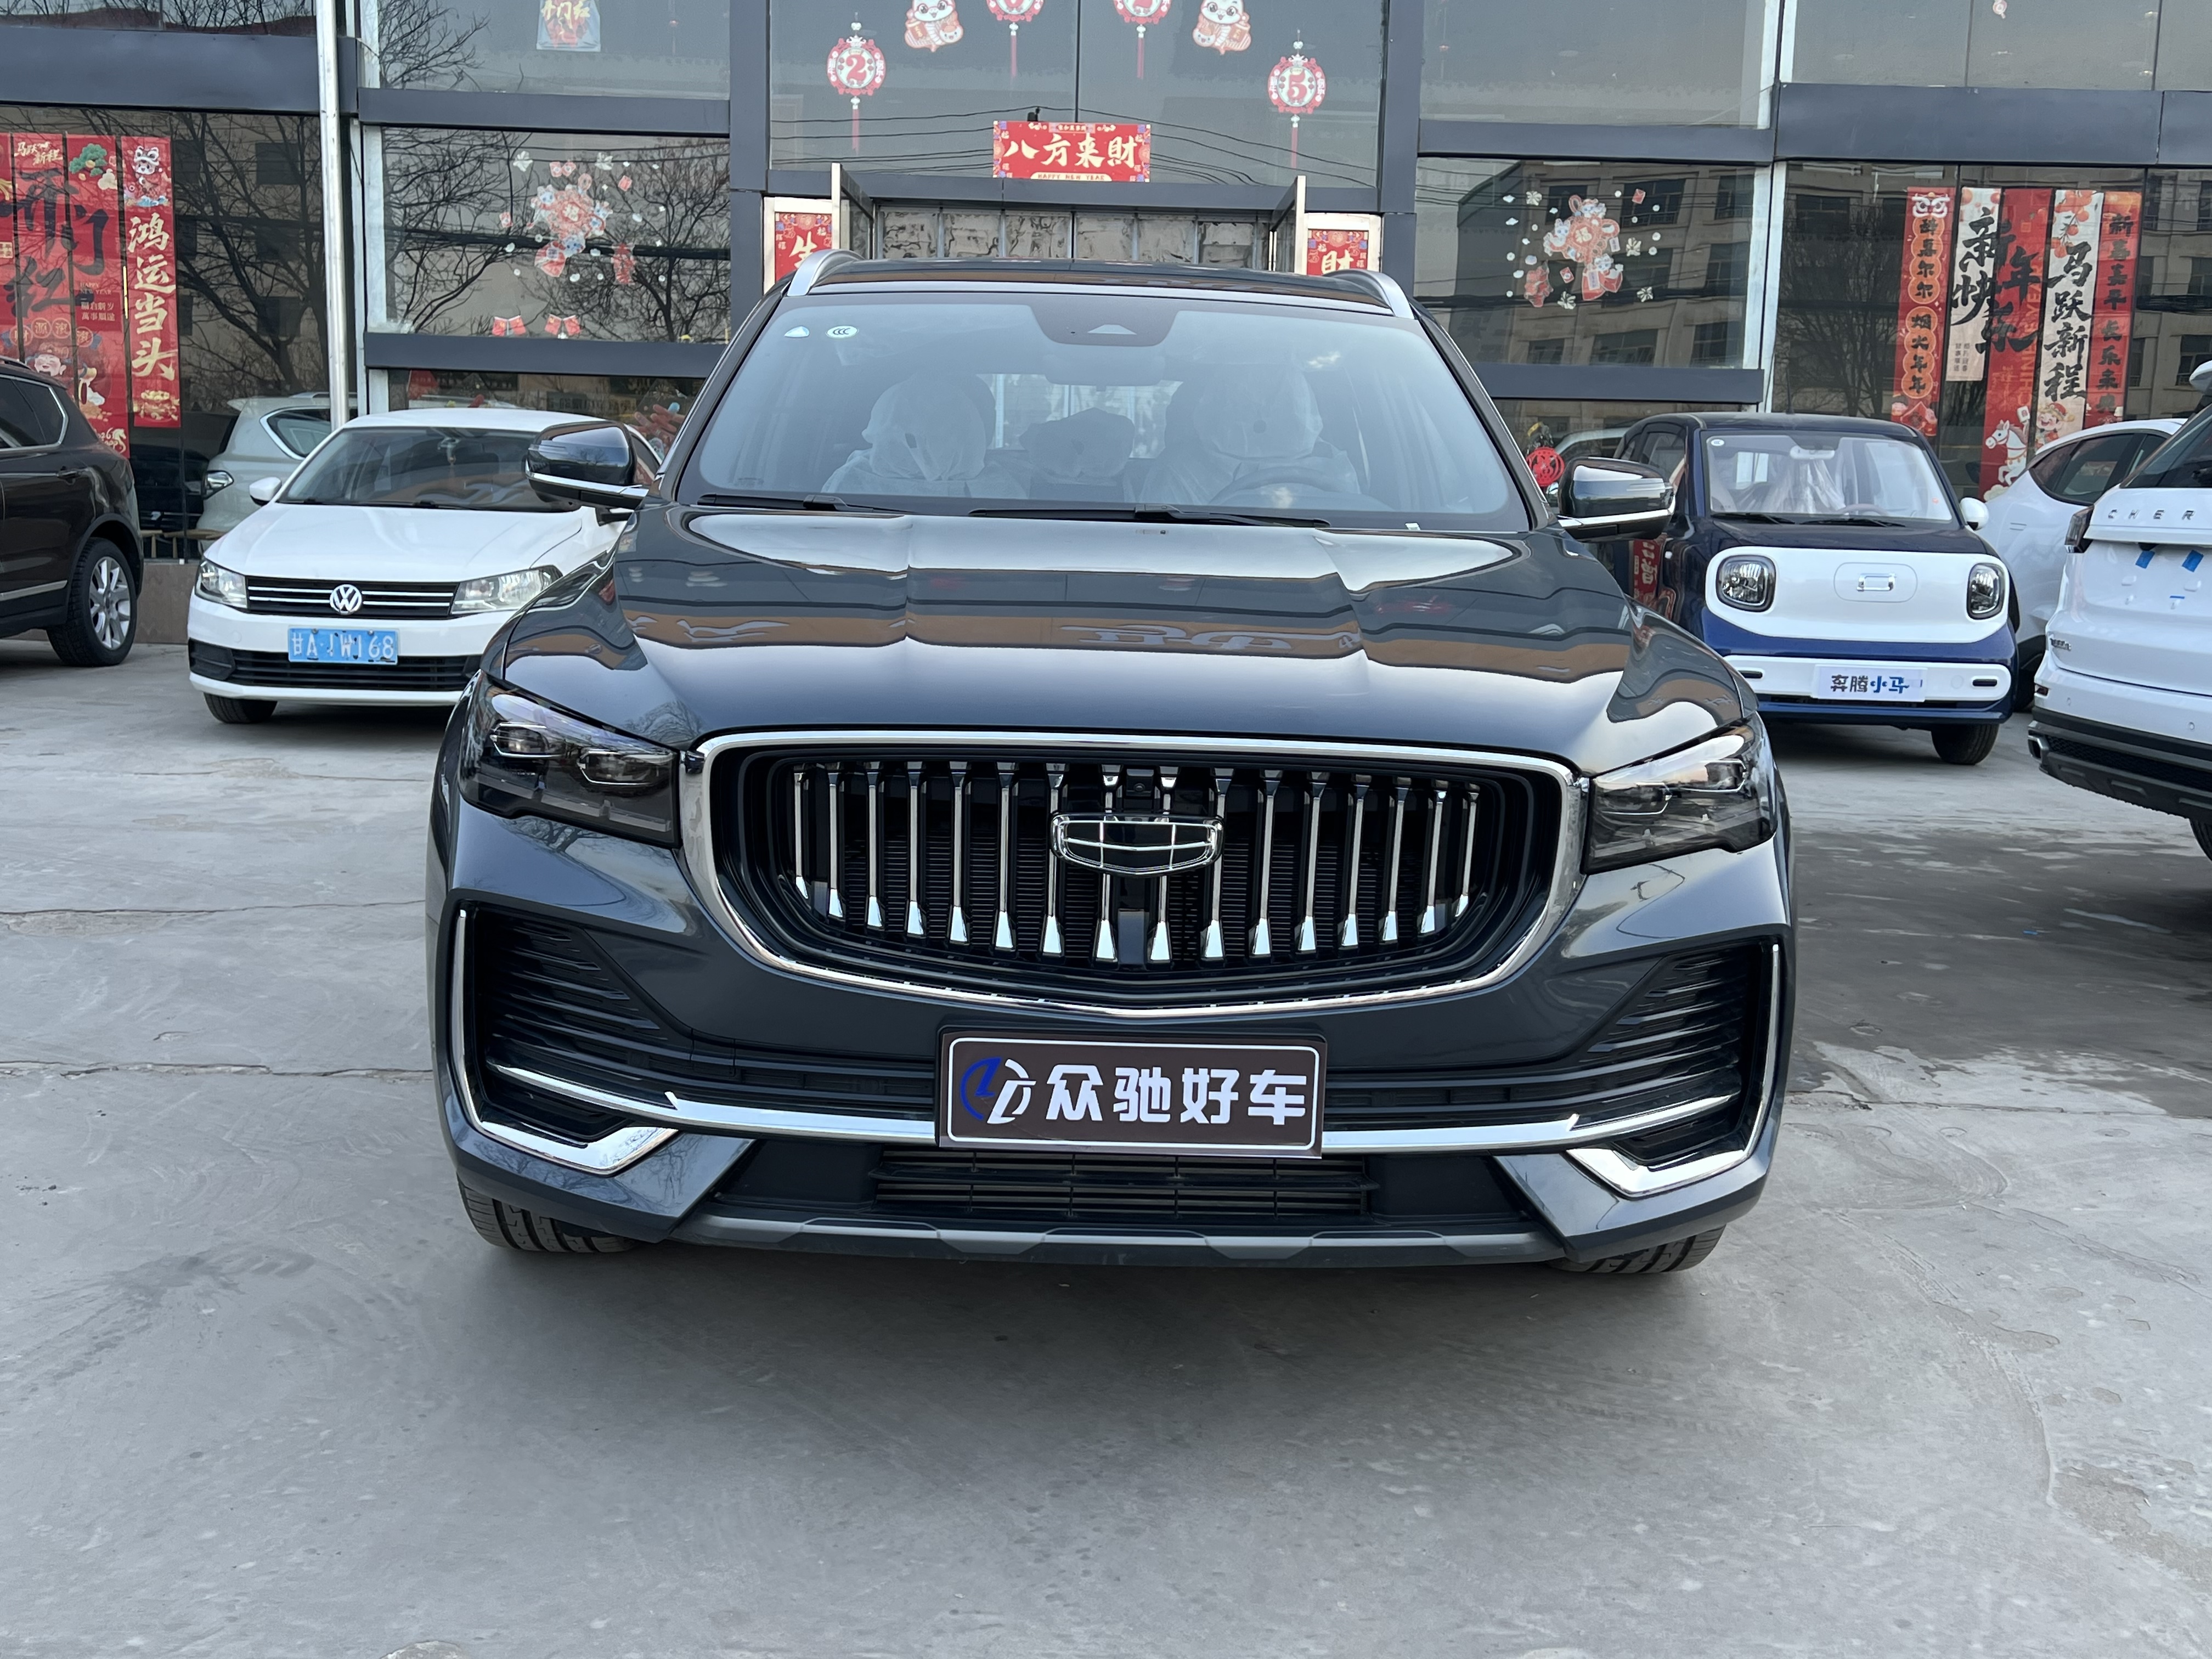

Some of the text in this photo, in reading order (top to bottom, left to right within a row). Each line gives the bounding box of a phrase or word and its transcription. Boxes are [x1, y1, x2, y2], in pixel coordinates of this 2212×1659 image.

[128, 212, 177, 381] 鸿运当头
[1830, 674, 1910, 694] 奔腾小马
[1046, 1064, 1307, 1125] 众驰好车
